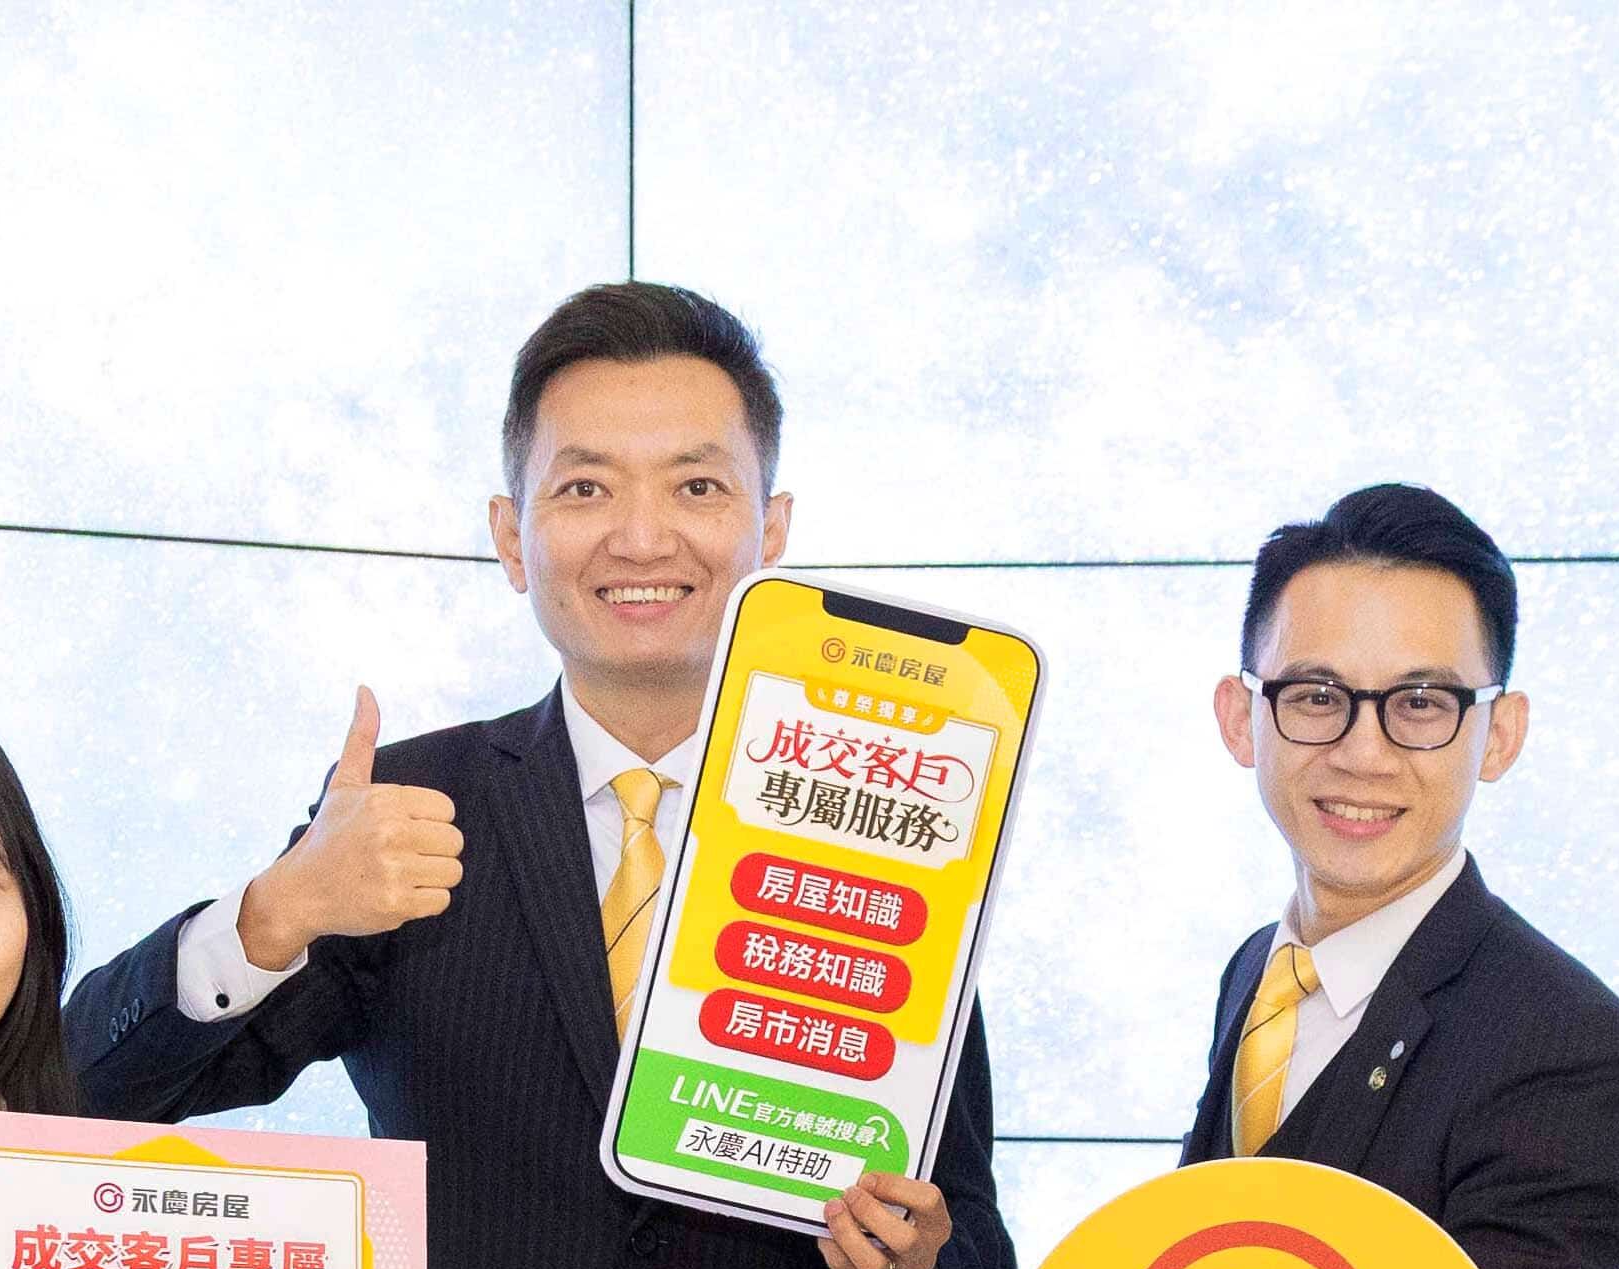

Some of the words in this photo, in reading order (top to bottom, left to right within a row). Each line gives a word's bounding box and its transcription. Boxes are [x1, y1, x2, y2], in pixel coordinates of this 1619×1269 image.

[851, 646, 948, 687] 永慶房屋
[746, 719, 975, 802] 成交客戶
[757, 769, 960, 852] 專屬服務
[757, 864, 903, 930] 房屋知識
[743, 931, 887, 998] 稅務知識
[725, 1000, 870, 1065] 房市消息
[131, 1187, 250, 1219] 永慶房屋
